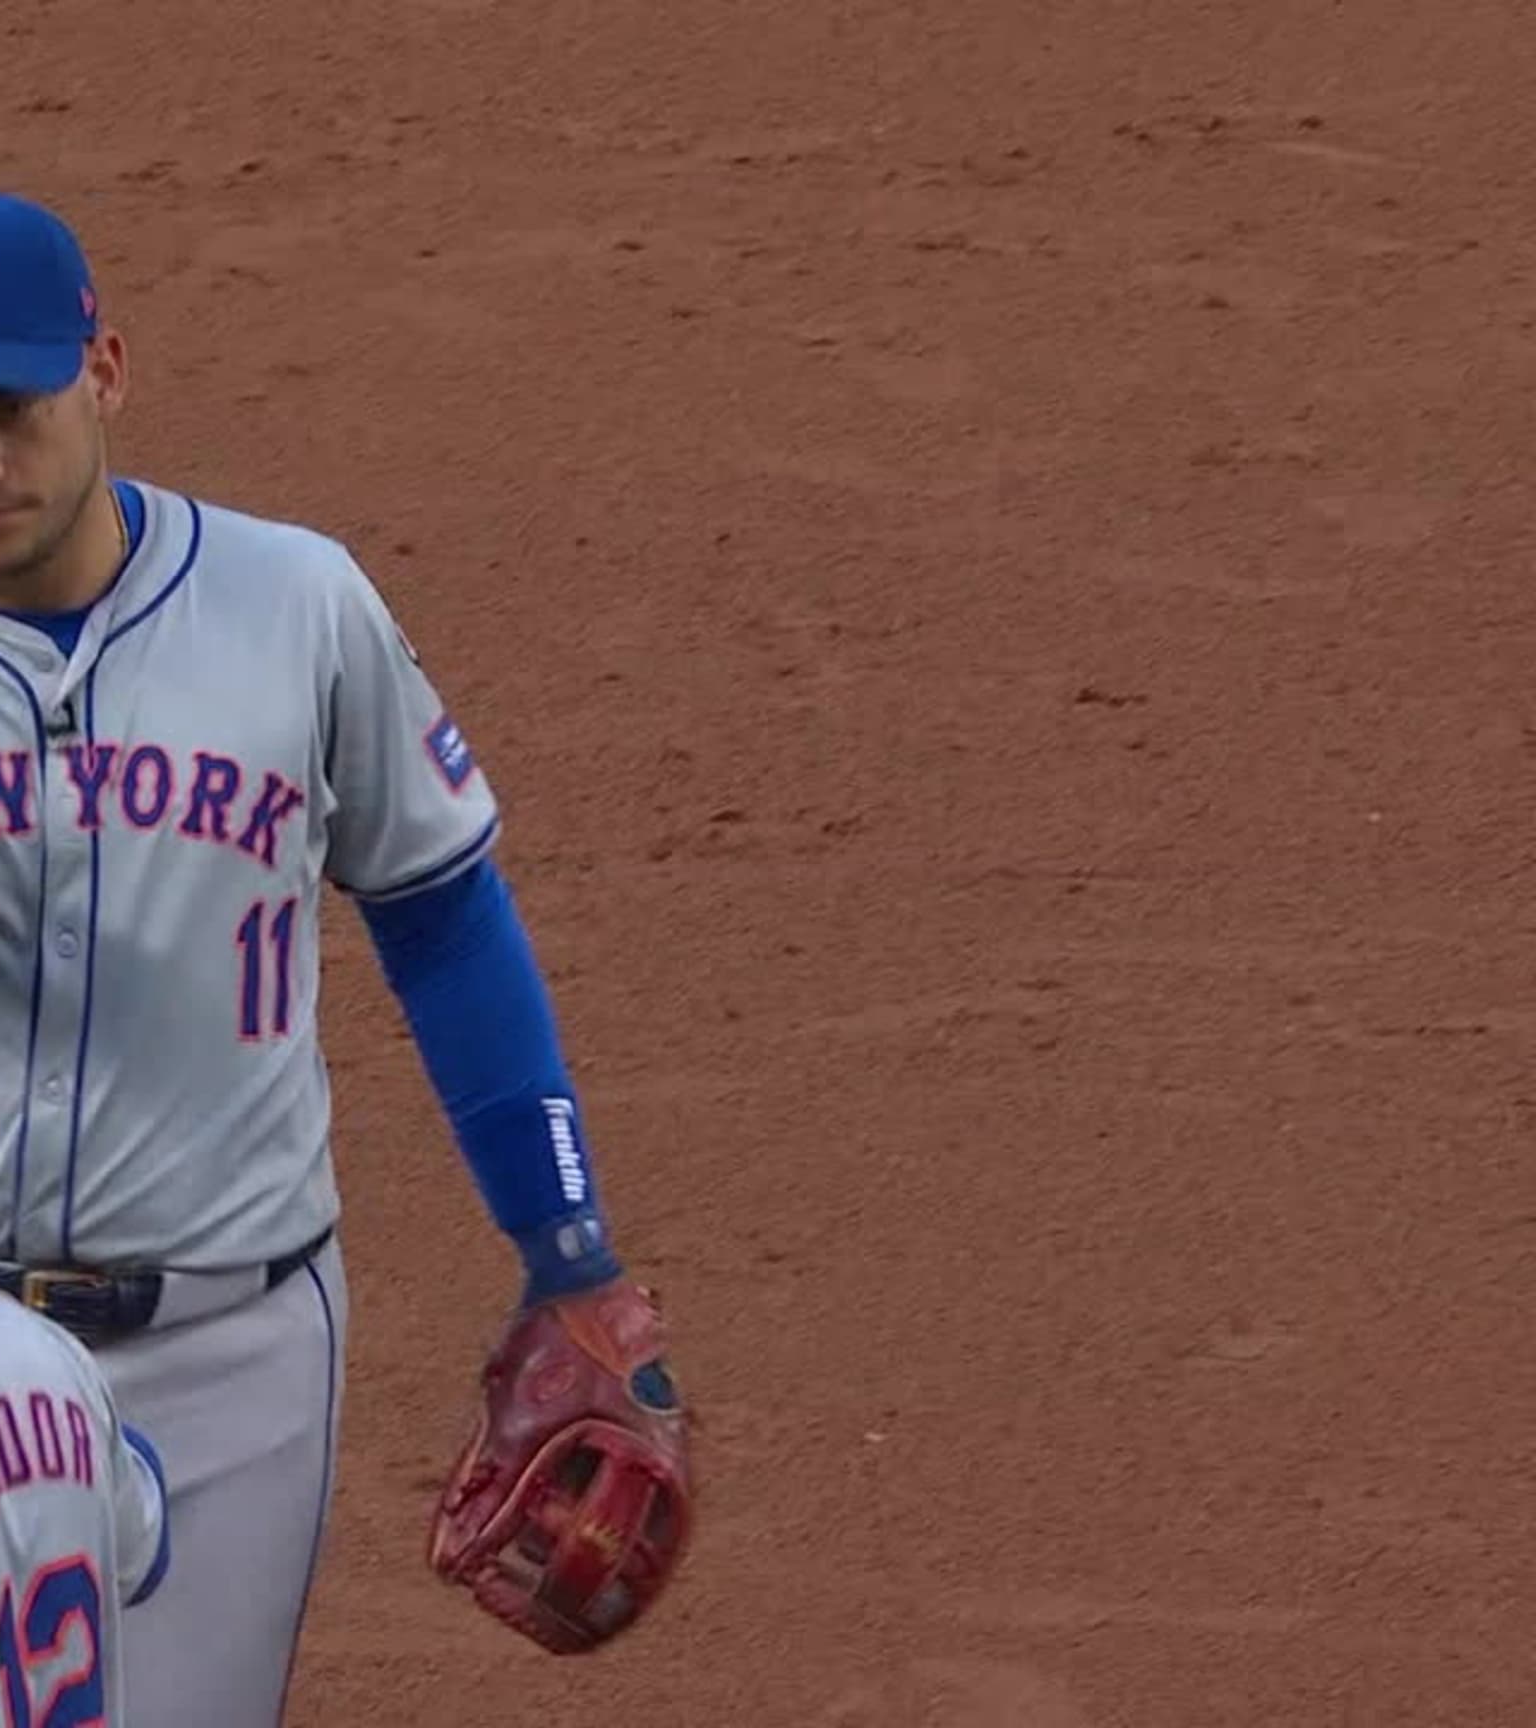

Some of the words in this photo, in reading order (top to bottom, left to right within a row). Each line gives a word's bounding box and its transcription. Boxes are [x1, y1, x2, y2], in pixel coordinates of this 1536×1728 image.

[64, 743, 304, 868] YORK
[235, 896, 300, 1043] 11
[541, 1097, 586, 1202] franklin
